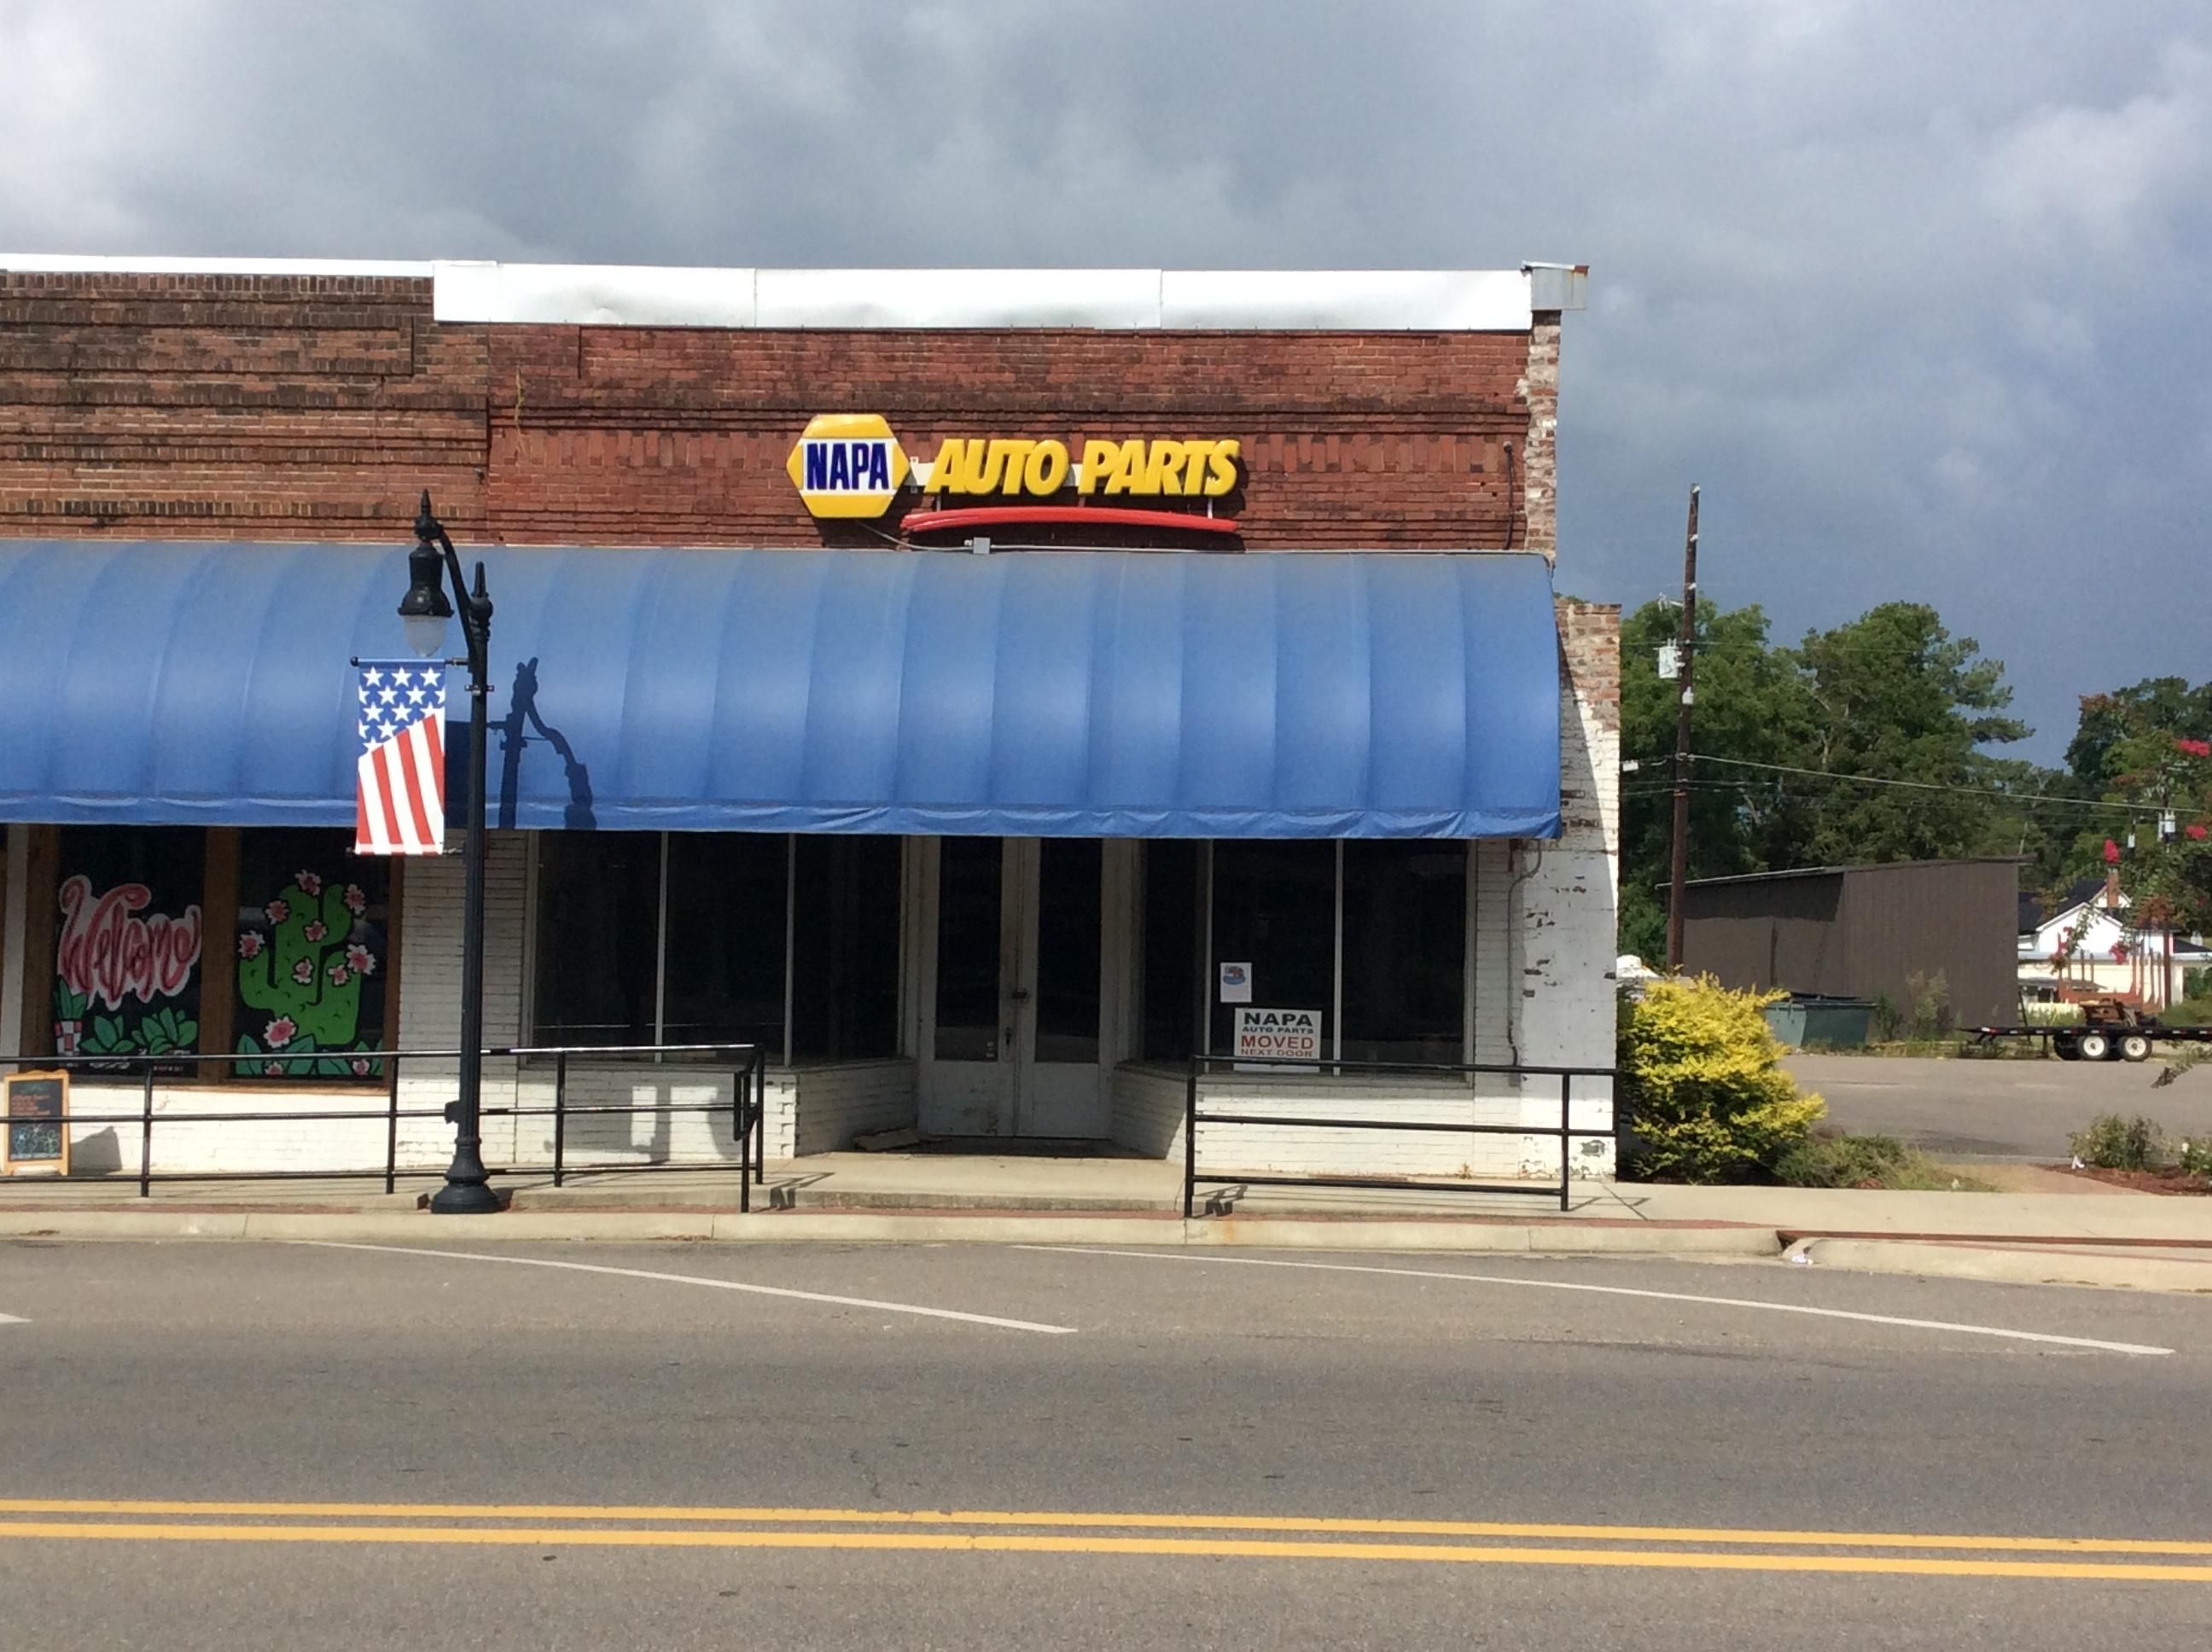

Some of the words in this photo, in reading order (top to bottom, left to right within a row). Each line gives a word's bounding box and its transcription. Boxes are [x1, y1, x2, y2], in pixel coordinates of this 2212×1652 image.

[806, 442, 888, 491] NAPA
[923, 438, 1069, 497] AUTO
[1076, 439, 1241, 497] PARTS
[1244, 1012, 1313, 1027] NAPA
[1241, 1035, 1314, 1050] MOVED
